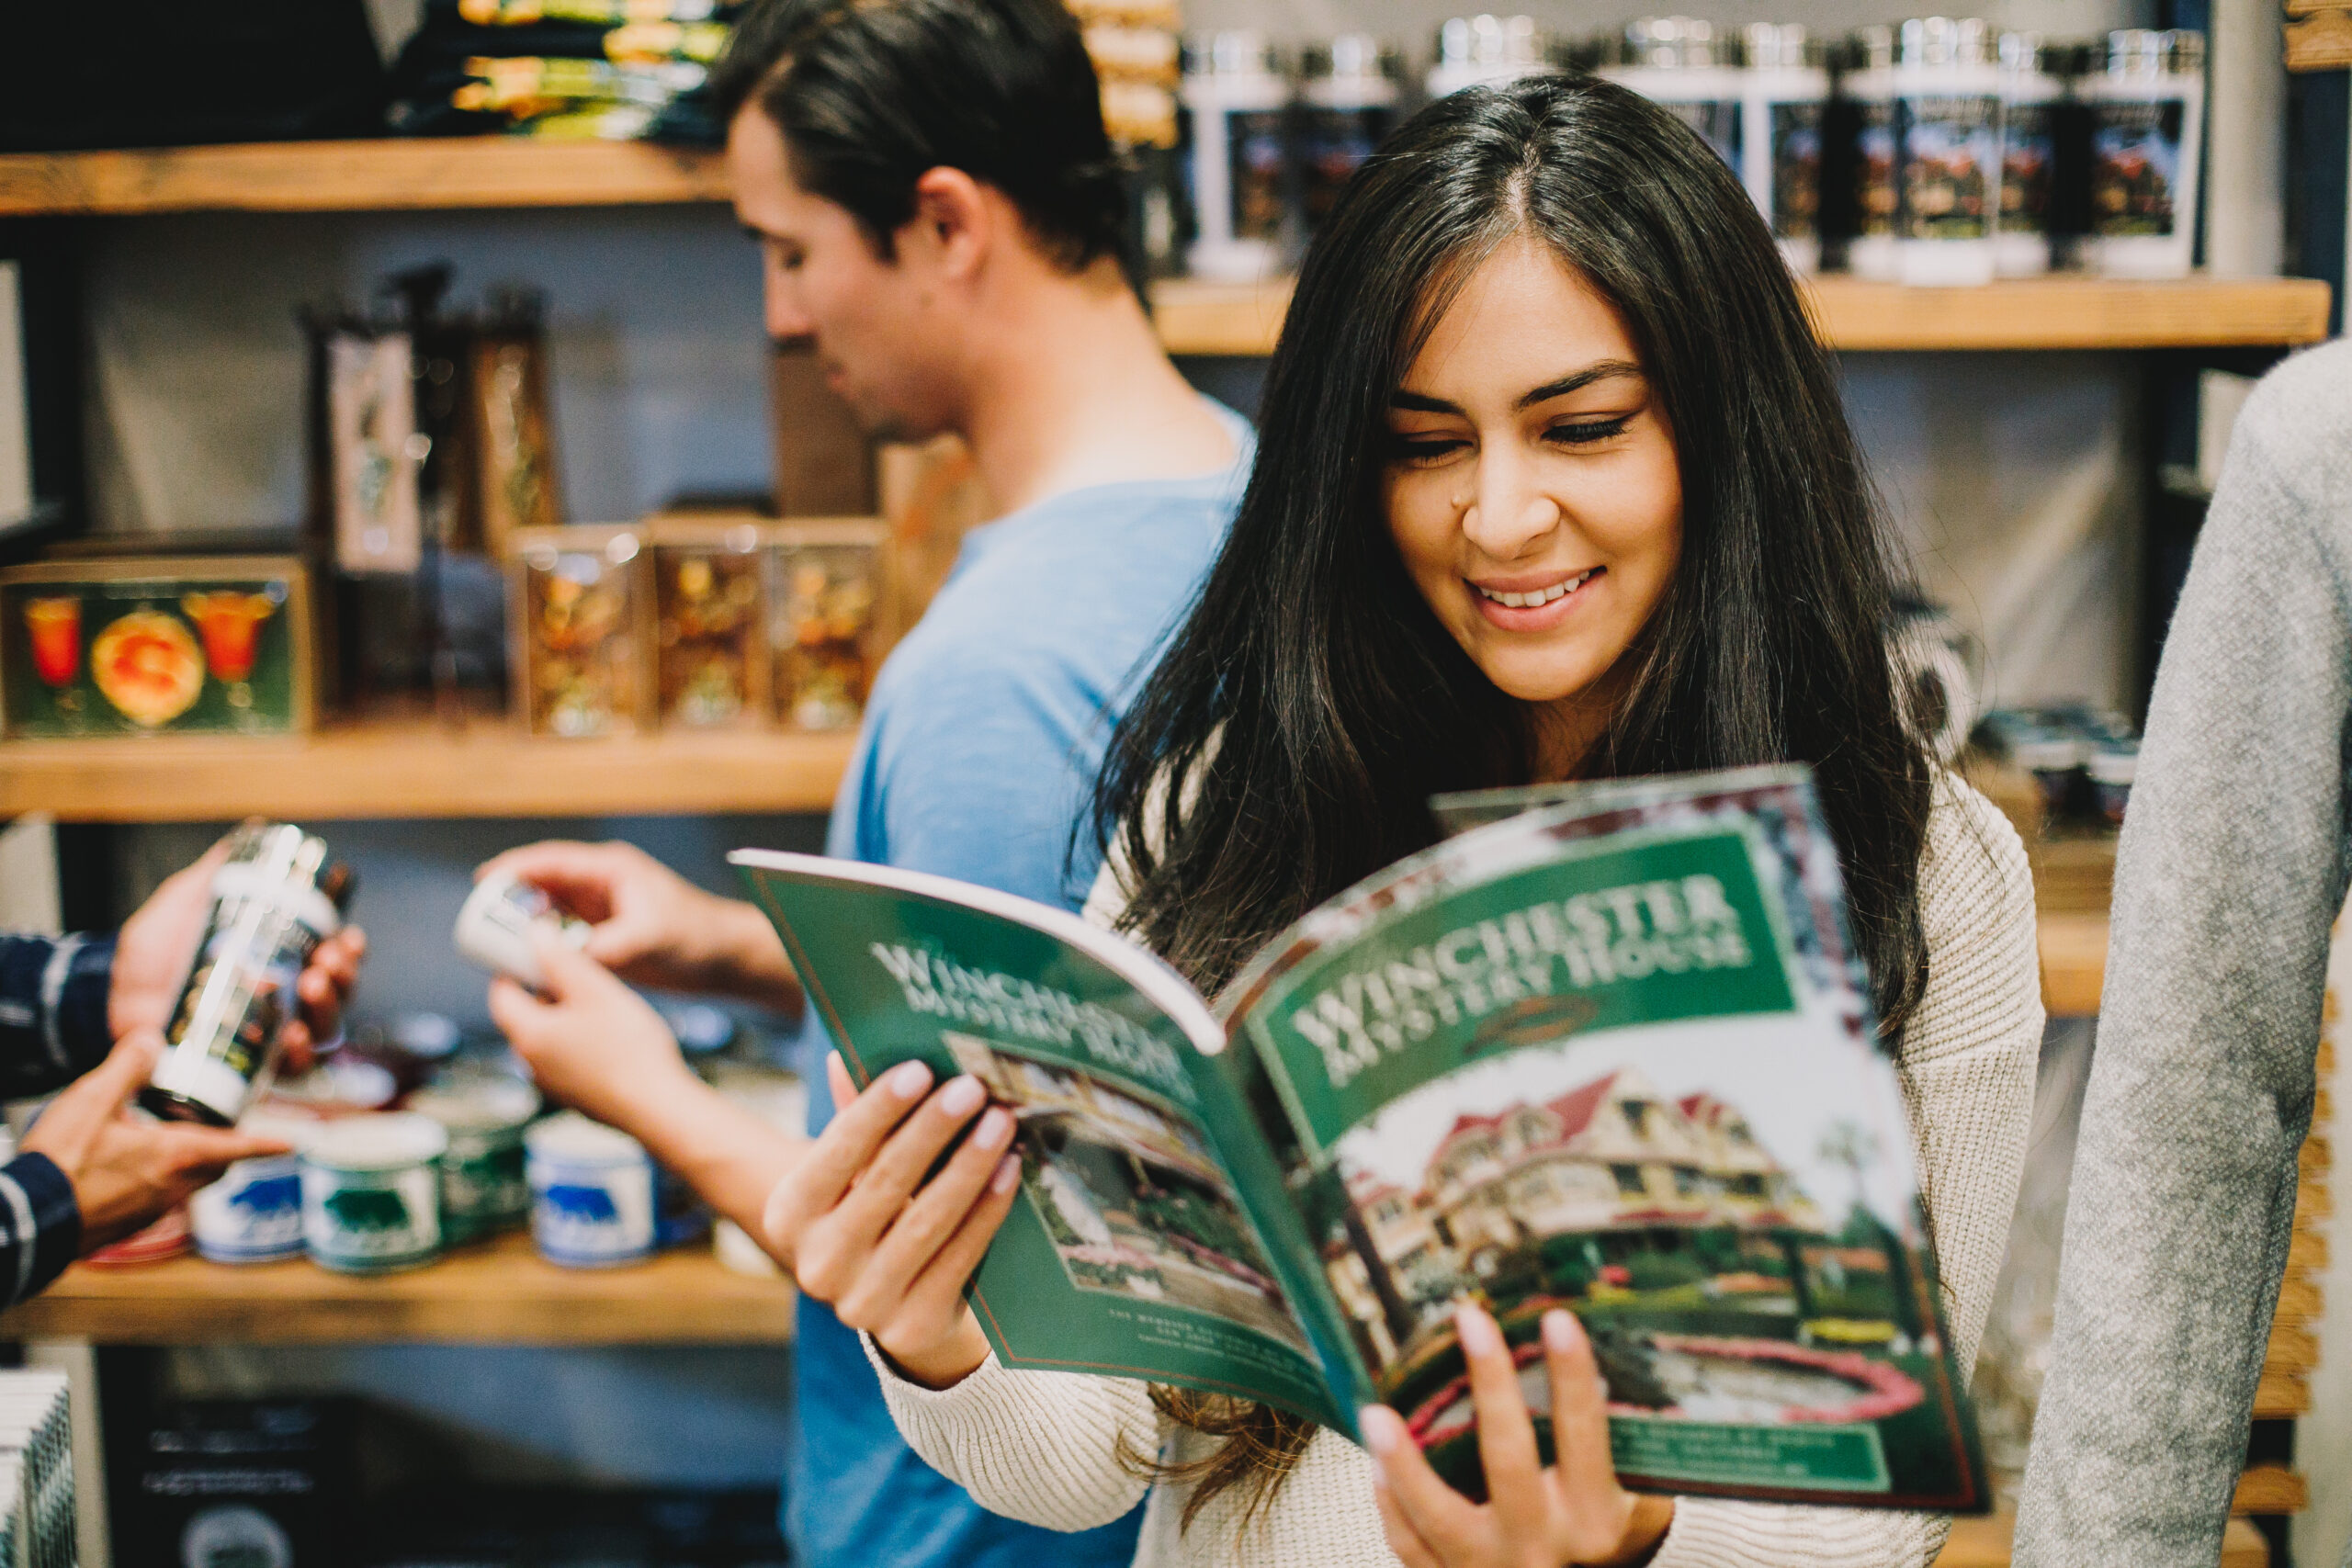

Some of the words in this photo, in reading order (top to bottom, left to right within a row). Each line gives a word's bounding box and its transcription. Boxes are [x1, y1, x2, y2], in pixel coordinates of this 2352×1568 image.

[869, 939, 1182, 1071] WINCH
[1289, 872, 1741, 1052] WINCHESTER
[1324, 949, 1554, 1089] MYSTERY
[1562, 928, 1754, 989] HOUSE
